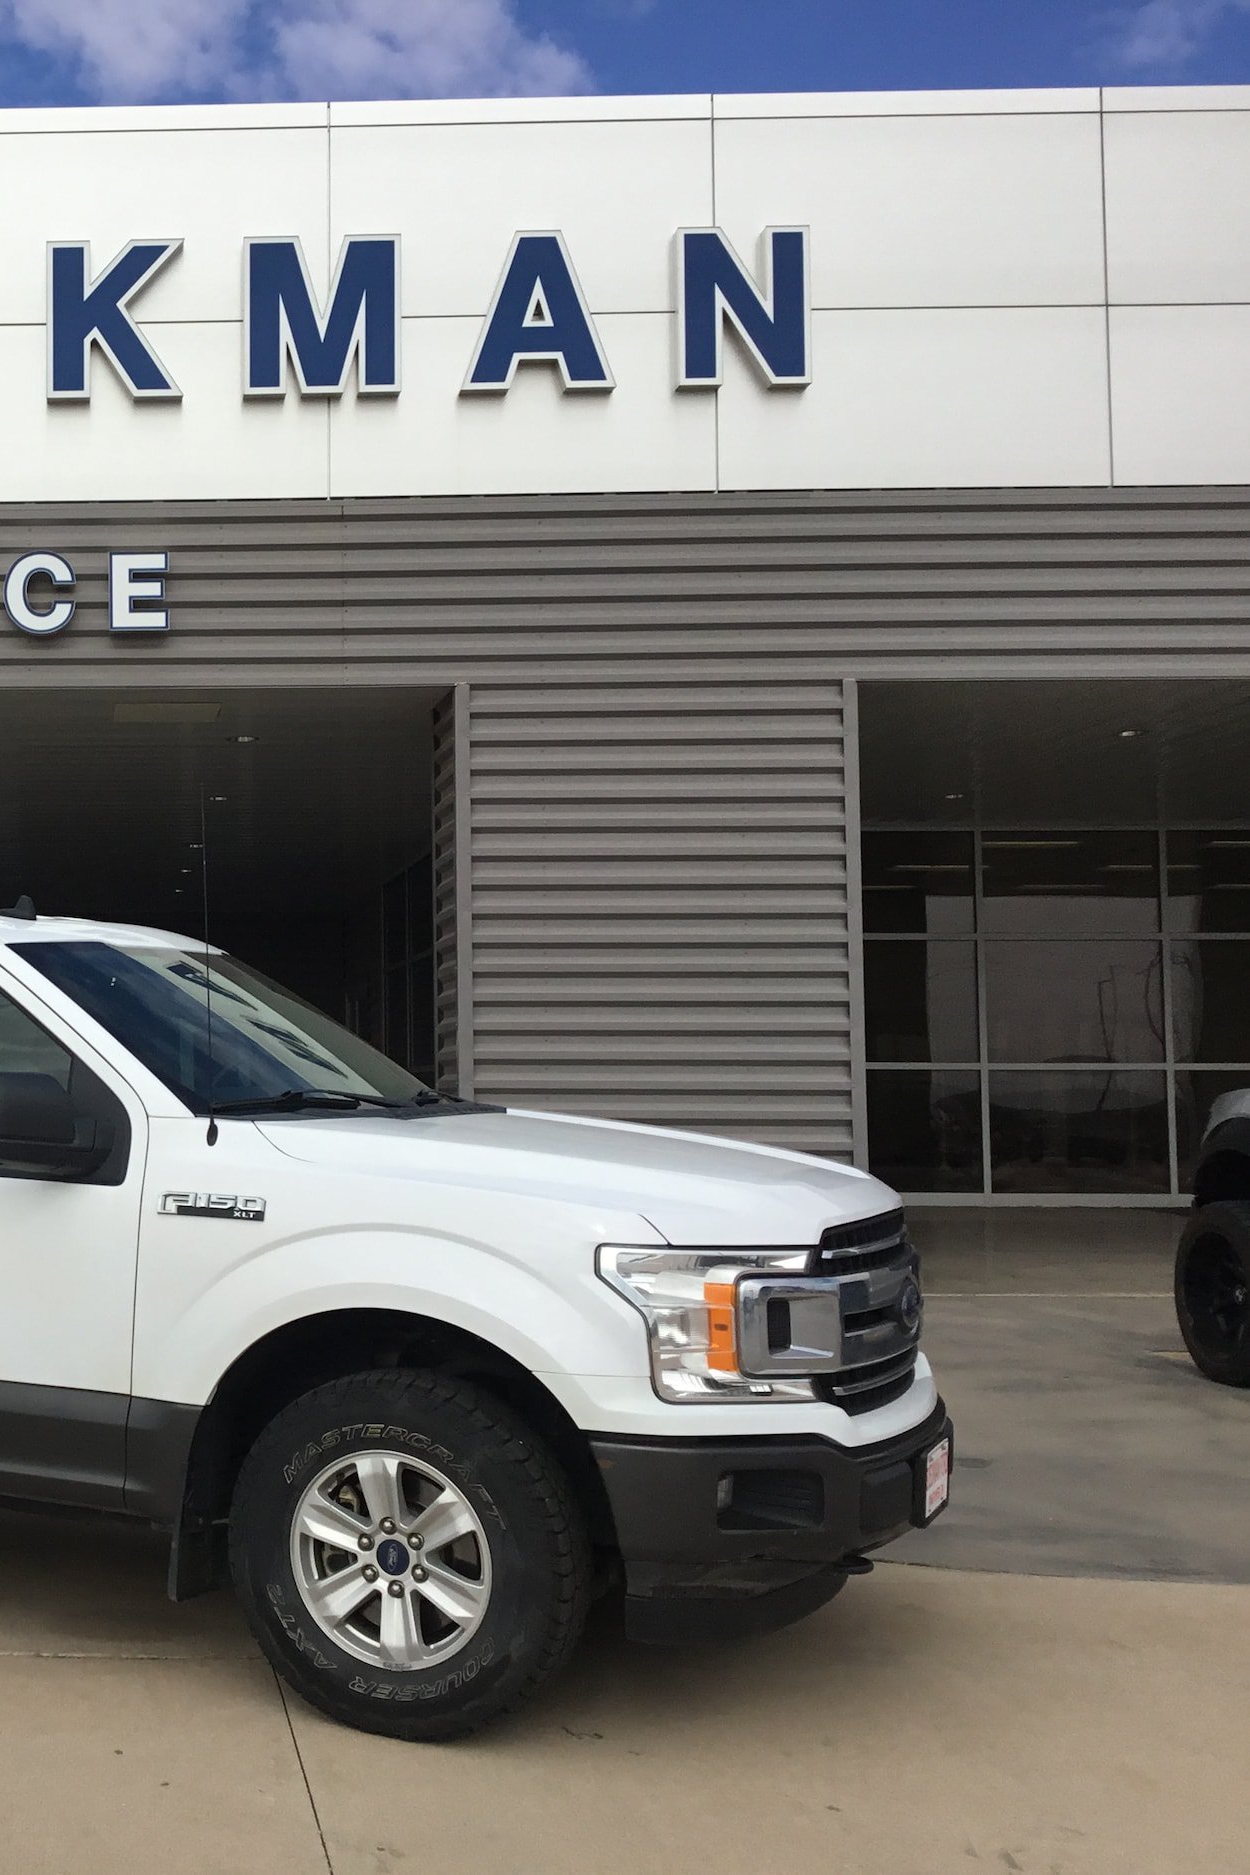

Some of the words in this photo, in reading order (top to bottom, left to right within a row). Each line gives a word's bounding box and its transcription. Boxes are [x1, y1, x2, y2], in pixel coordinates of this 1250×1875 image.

[232, 1209, 257, 1220] XLT
[282, 1423, 509, 1531] MASTERCRAFT
[348, 1636, 496, 1702] COURSER
